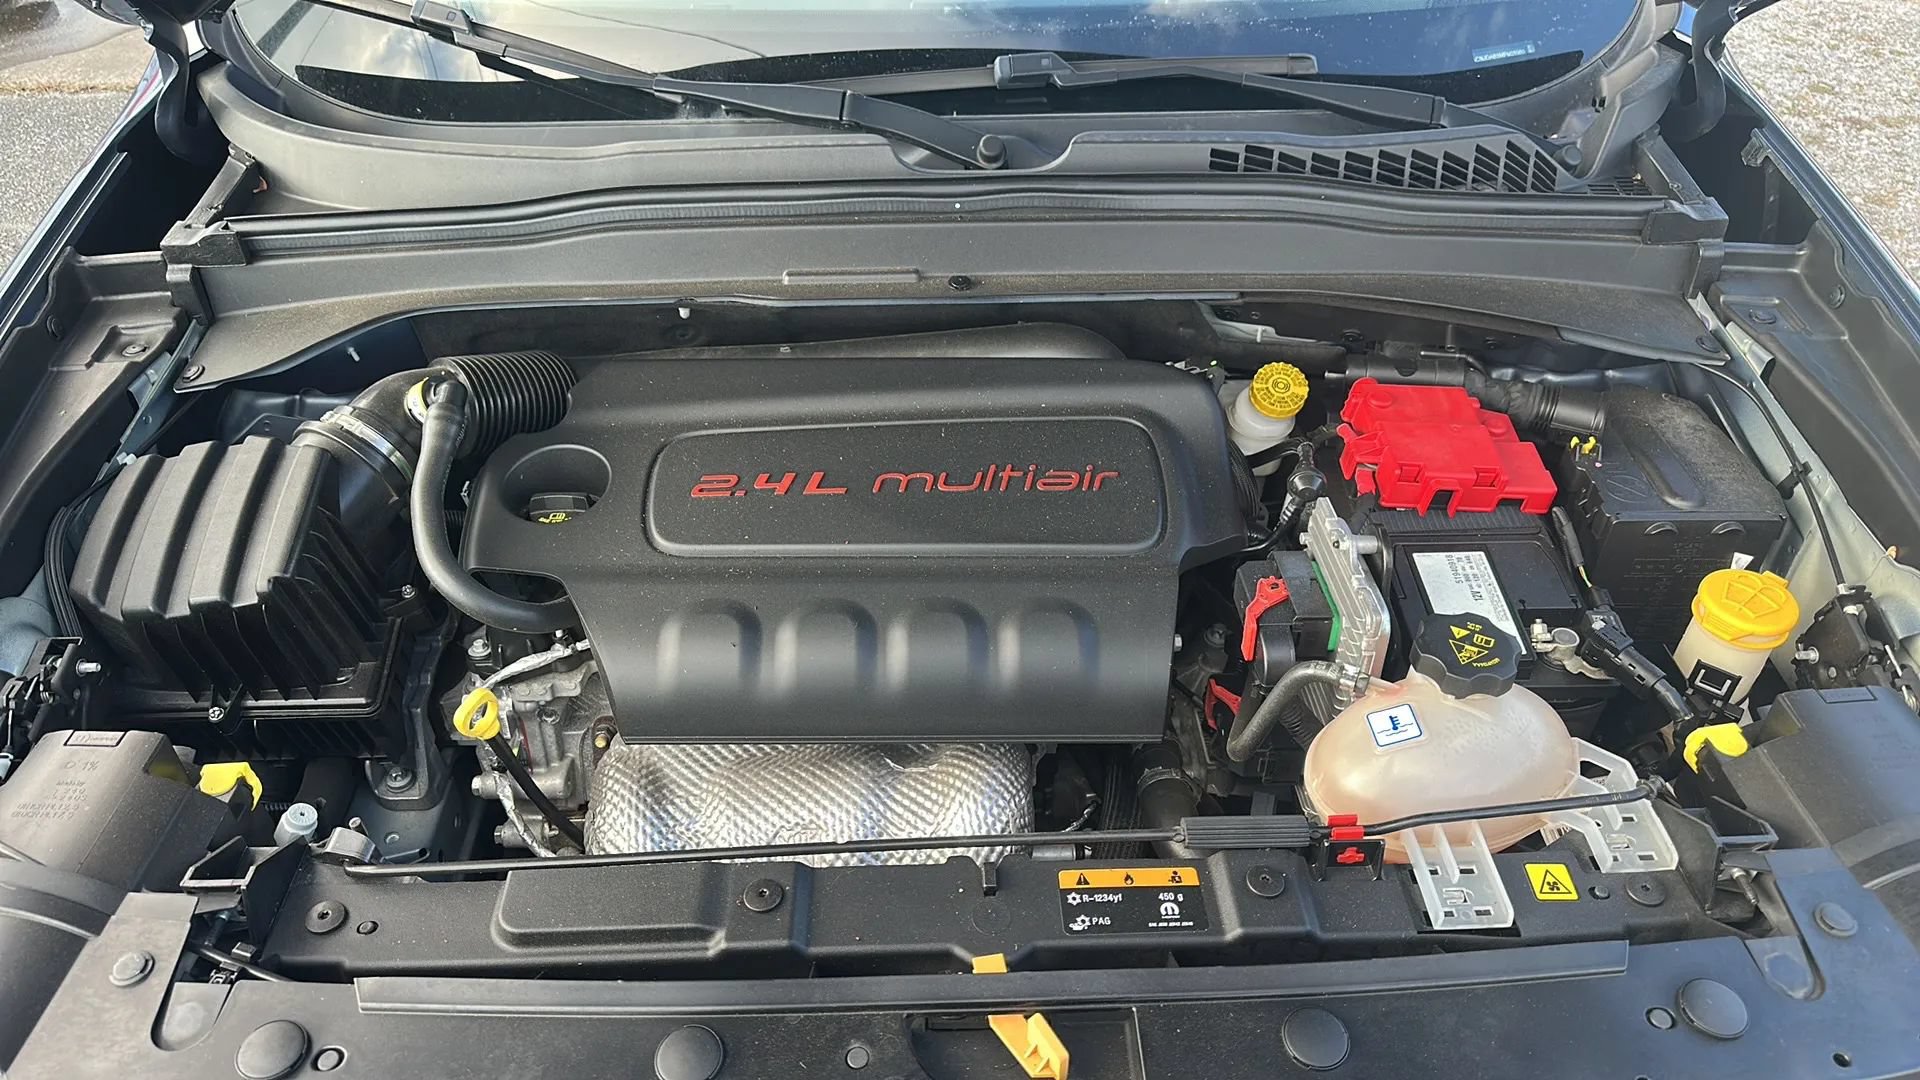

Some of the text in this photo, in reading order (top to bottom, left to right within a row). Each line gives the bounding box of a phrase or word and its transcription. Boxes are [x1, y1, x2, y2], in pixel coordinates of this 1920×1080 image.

[873, 464, 1120, 493] multiair
[1445, 554, 1464, 584] 51940918
[1471, 590, 1485, 602] 12V
[1082, 892, 1184, 904] R-1234yf 450 g
[1092, 916, 1111, 925] PAG
